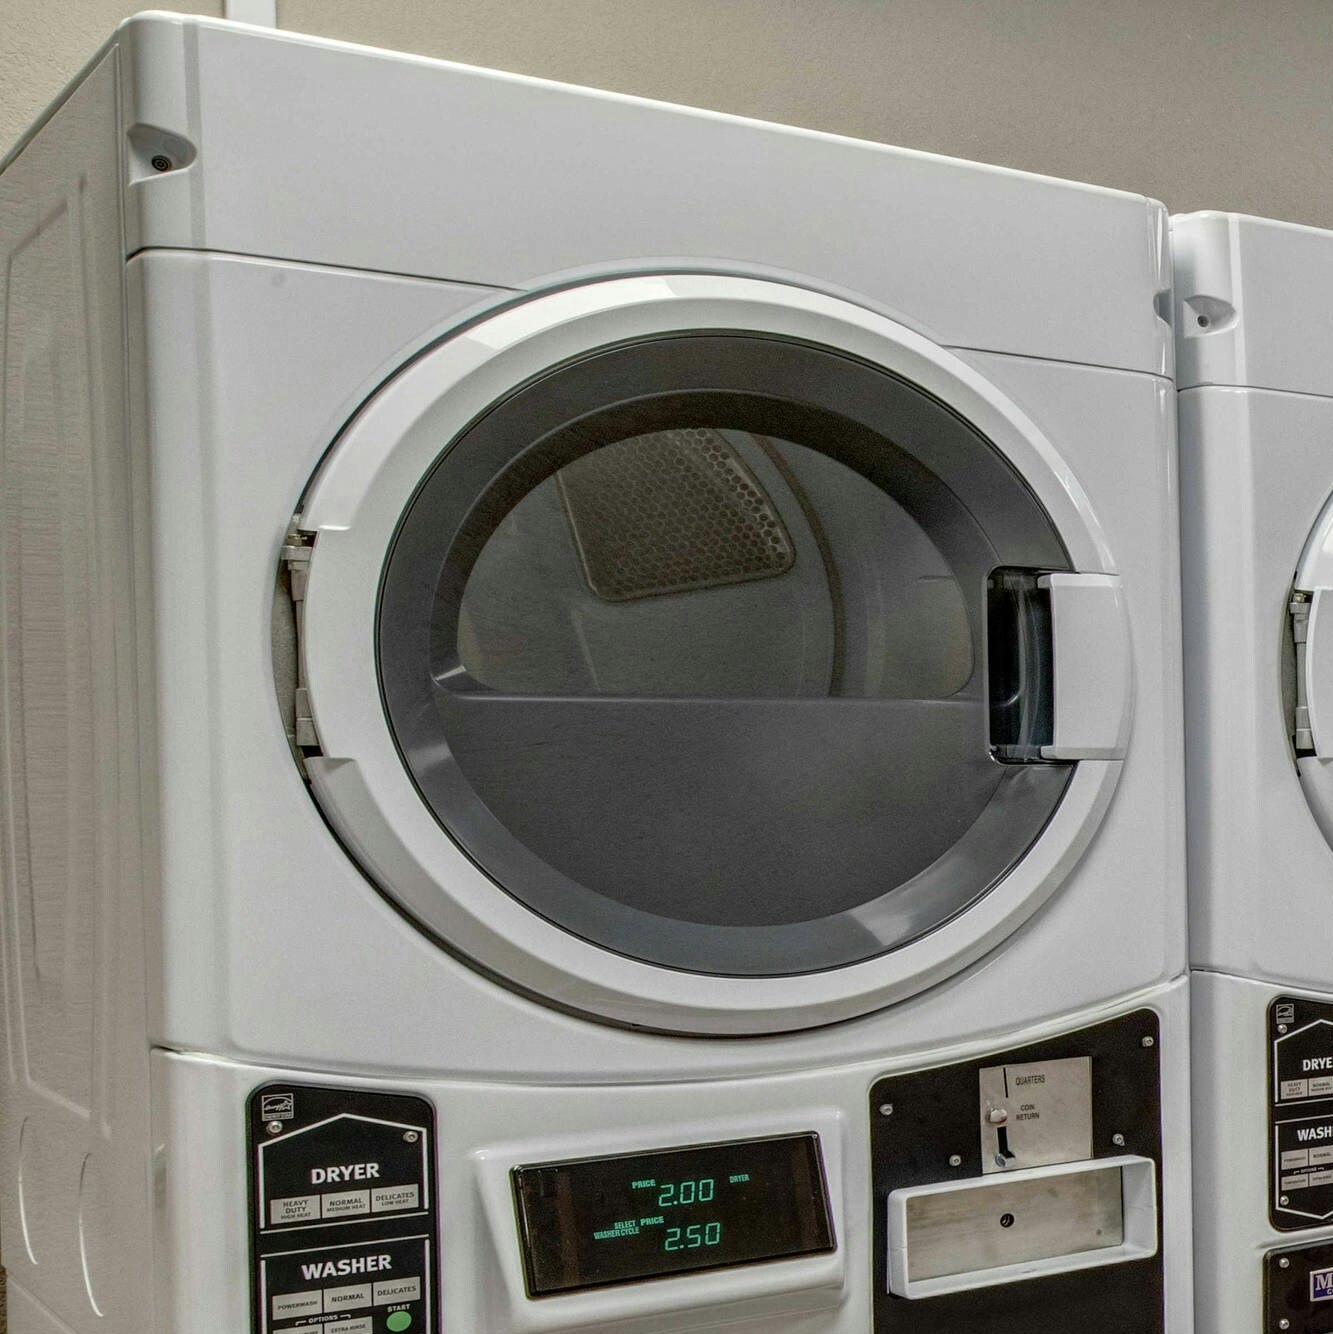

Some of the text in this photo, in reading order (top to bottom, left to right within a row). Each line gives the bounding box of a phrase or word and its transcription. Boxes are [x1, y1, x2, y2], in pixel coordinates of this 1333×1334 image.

[1015, 1074, 1046, 1086] QUARTERS
[1015, 1111, 1040, 1121] RETURN
[311, 1162, 380, 1184] DRYER
[375, 1191, 415, 1202] DELICATES
[631, 1178, 656, 1189] PRICE
[658, 1178, 715, 1207] 2.00
[283, 1199, 309, 1207] HEAVY
[329, 1197, 363, 1207] NORMAL
[285, 1206, 307, 1214] DUTY
[614, 1215, 665, 1229] SELECT PRICE
[664, 1222, 721, 1251] 2.50
[301, 1254, 392, 1281] WASHER
[377, 1285, 417, 1297] DELICATES
[330, 1293, 365, 1303] NORMAL
[387, 1304, 411, 1313] START
[308, 1314, 339, 1324] OPTIONS
